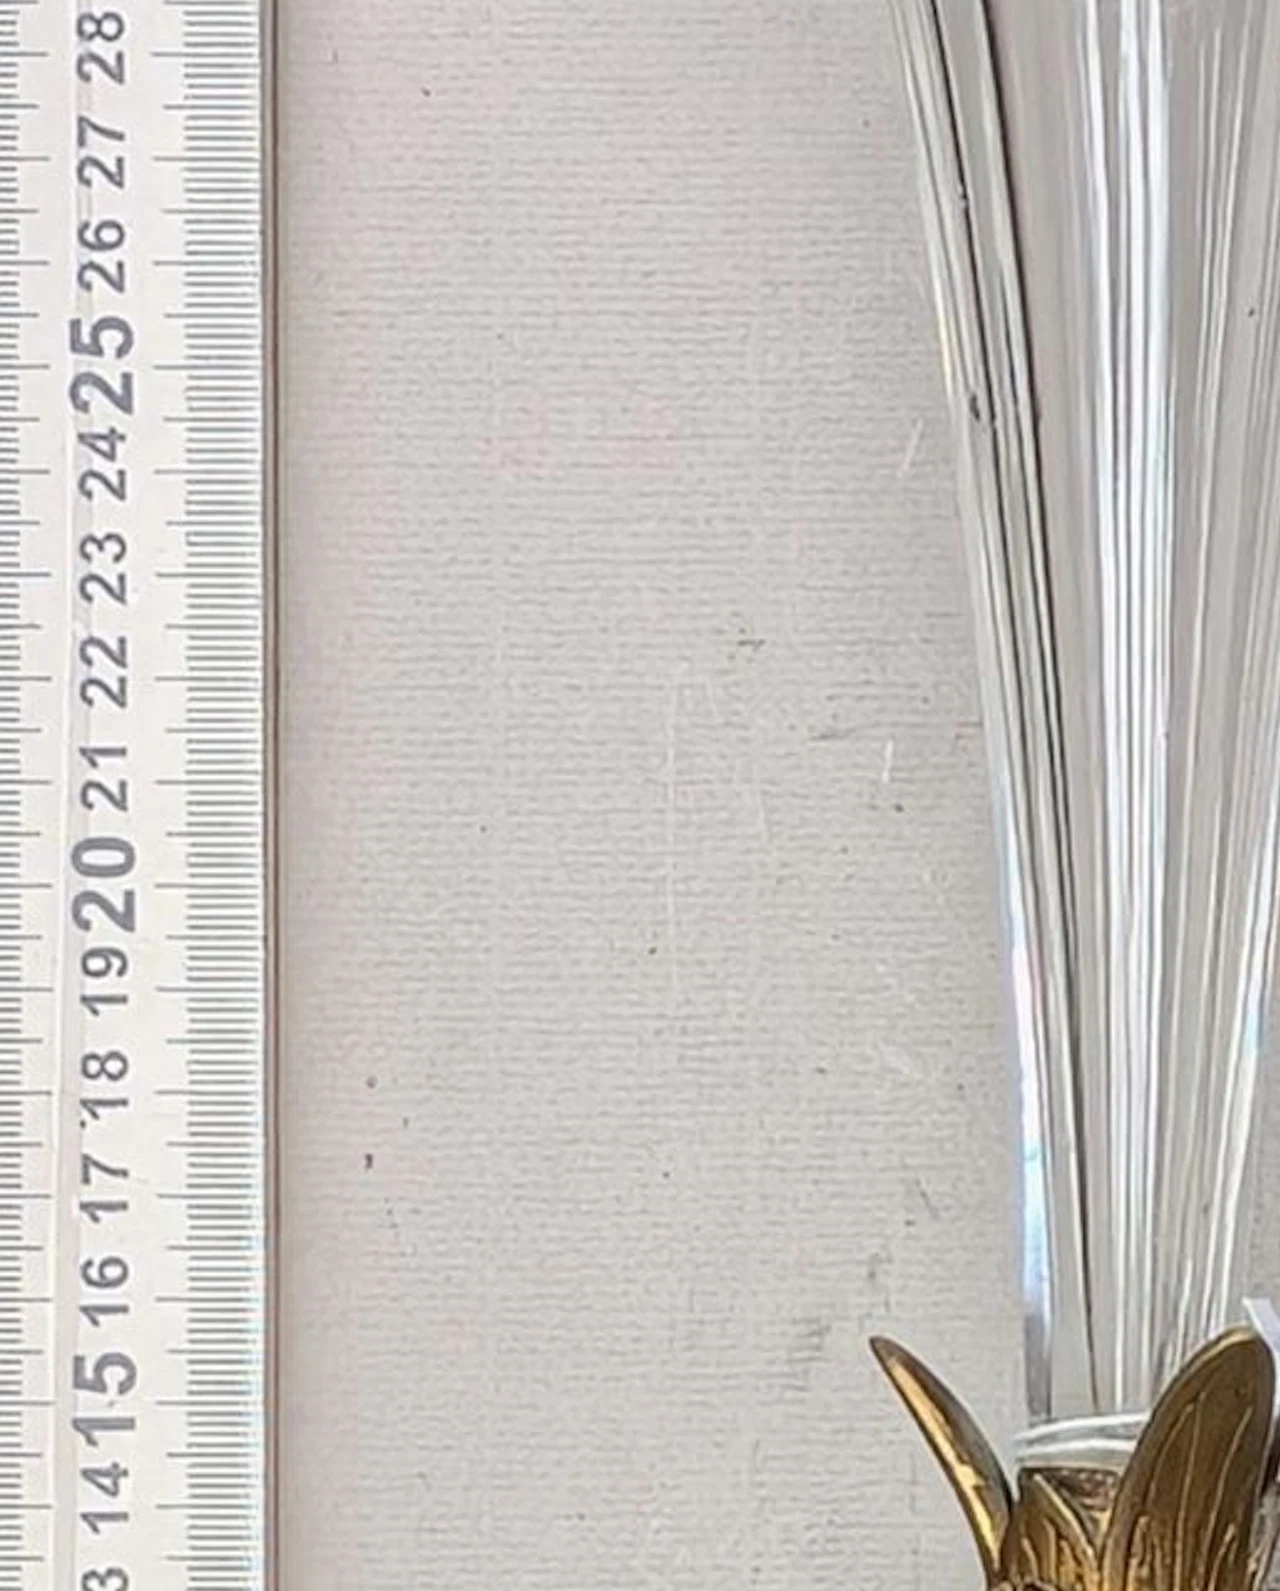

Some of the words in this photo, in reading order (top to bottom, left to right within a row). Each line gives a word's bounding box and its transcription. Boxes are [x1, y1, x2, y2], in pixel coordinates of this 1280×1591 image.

[74, 10, 126, 86] 28
[75, 113, 127, 190] 27
[75, 218, 127, 295] 26
[67, 315, 135, 417] 25
[75, 425, 128, 503] 24
[75, 531, 128, 606] 23
[77, 633, 129, 710] 22
[77, 745, 129, 814] 21
[69, 835, 137, 934] 20
[78, 946, 130, 1018] 19
[77, 1049, 130, 1122] 18
[78, 1153, 131, 1225] 17
[76, 1255, 131, 1328] 16
[69, 1351, 138, 1449] 15
[78, 1460, 130, 1536] 14
